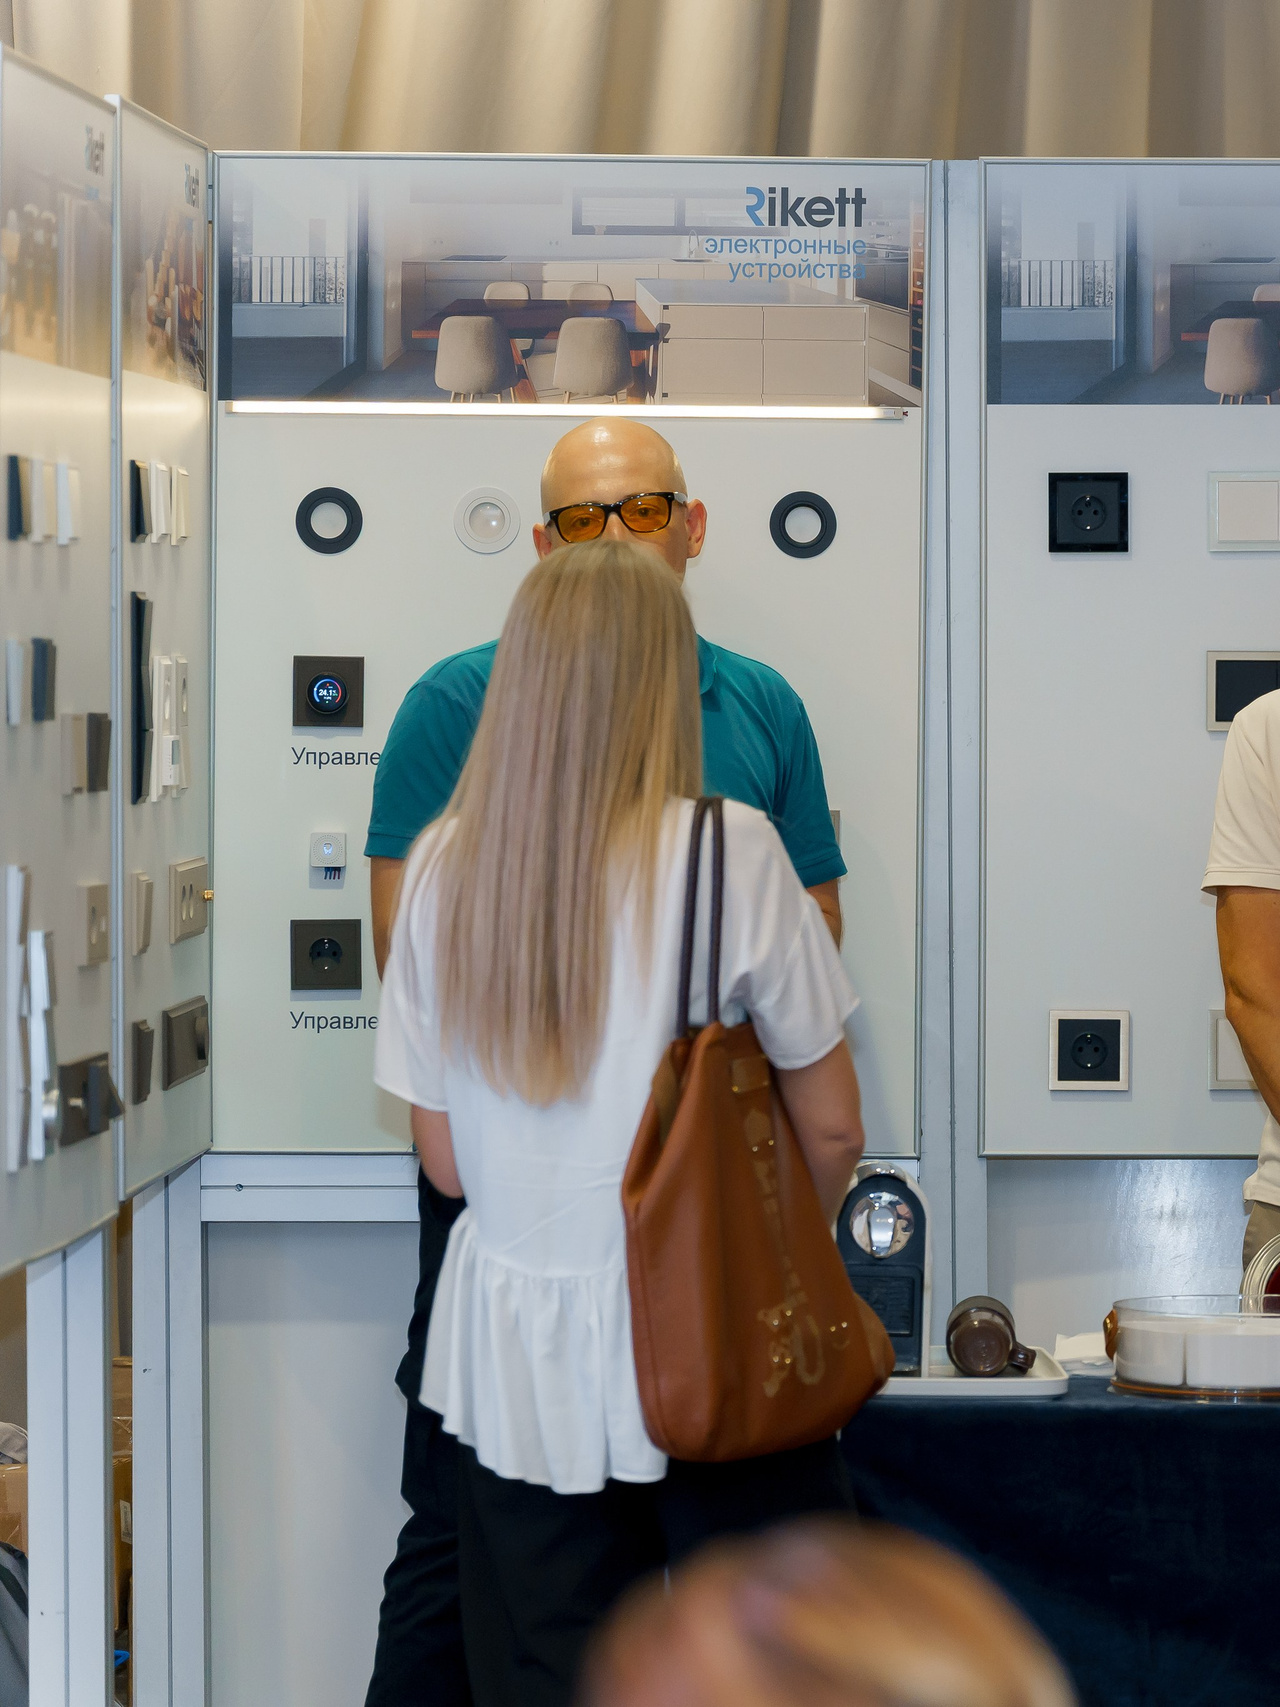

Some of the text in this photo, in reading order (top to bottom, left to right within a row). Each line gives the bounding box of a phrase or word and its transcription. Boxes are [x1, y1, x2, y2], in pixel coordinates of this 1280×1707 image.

[746, 187, 867, 227] Rikett
[705, 238, 867, 259] электронные
[728, 258, 867, 283] устройства
[291, 747, 381, 769] Управле
